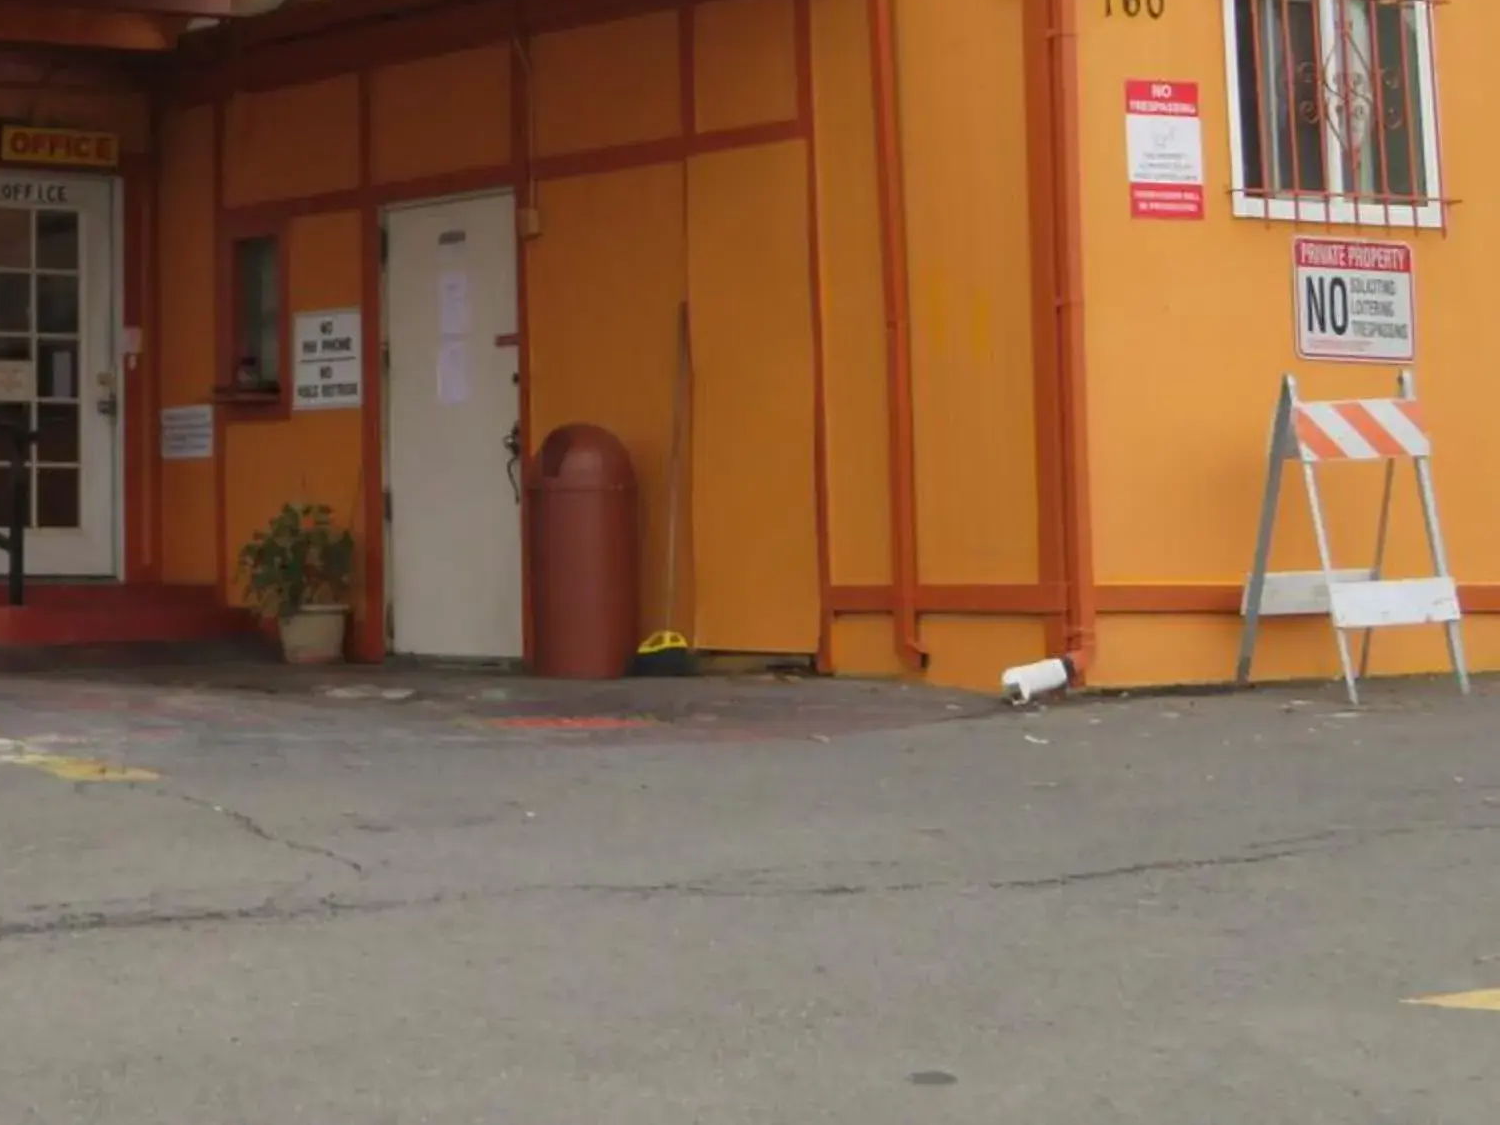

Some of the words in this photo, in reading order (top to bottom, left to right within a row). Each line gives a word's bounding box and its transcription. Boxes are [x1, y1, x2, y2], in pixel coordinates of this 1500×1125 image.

[1151, 84, 1171, 98] NO
[1129, 100, 1196, 114] TRESPASSING
[10, 130, 113, 160] OFFICE
[2, 183, 68, 204] OFFICE
[1301, 242, 1348, 267] PRIVATE
[1349, 246, 1407, 270] PROPERTY
[1350, 277, 1396, 296] SOLICITING
[1306, 276, 1348, 335] NO
[1351, 299, 1395, 317] LOITERING
[1351, 320, 1408, 339] TRESPASSING
[319, 366, 333, 379] NO
